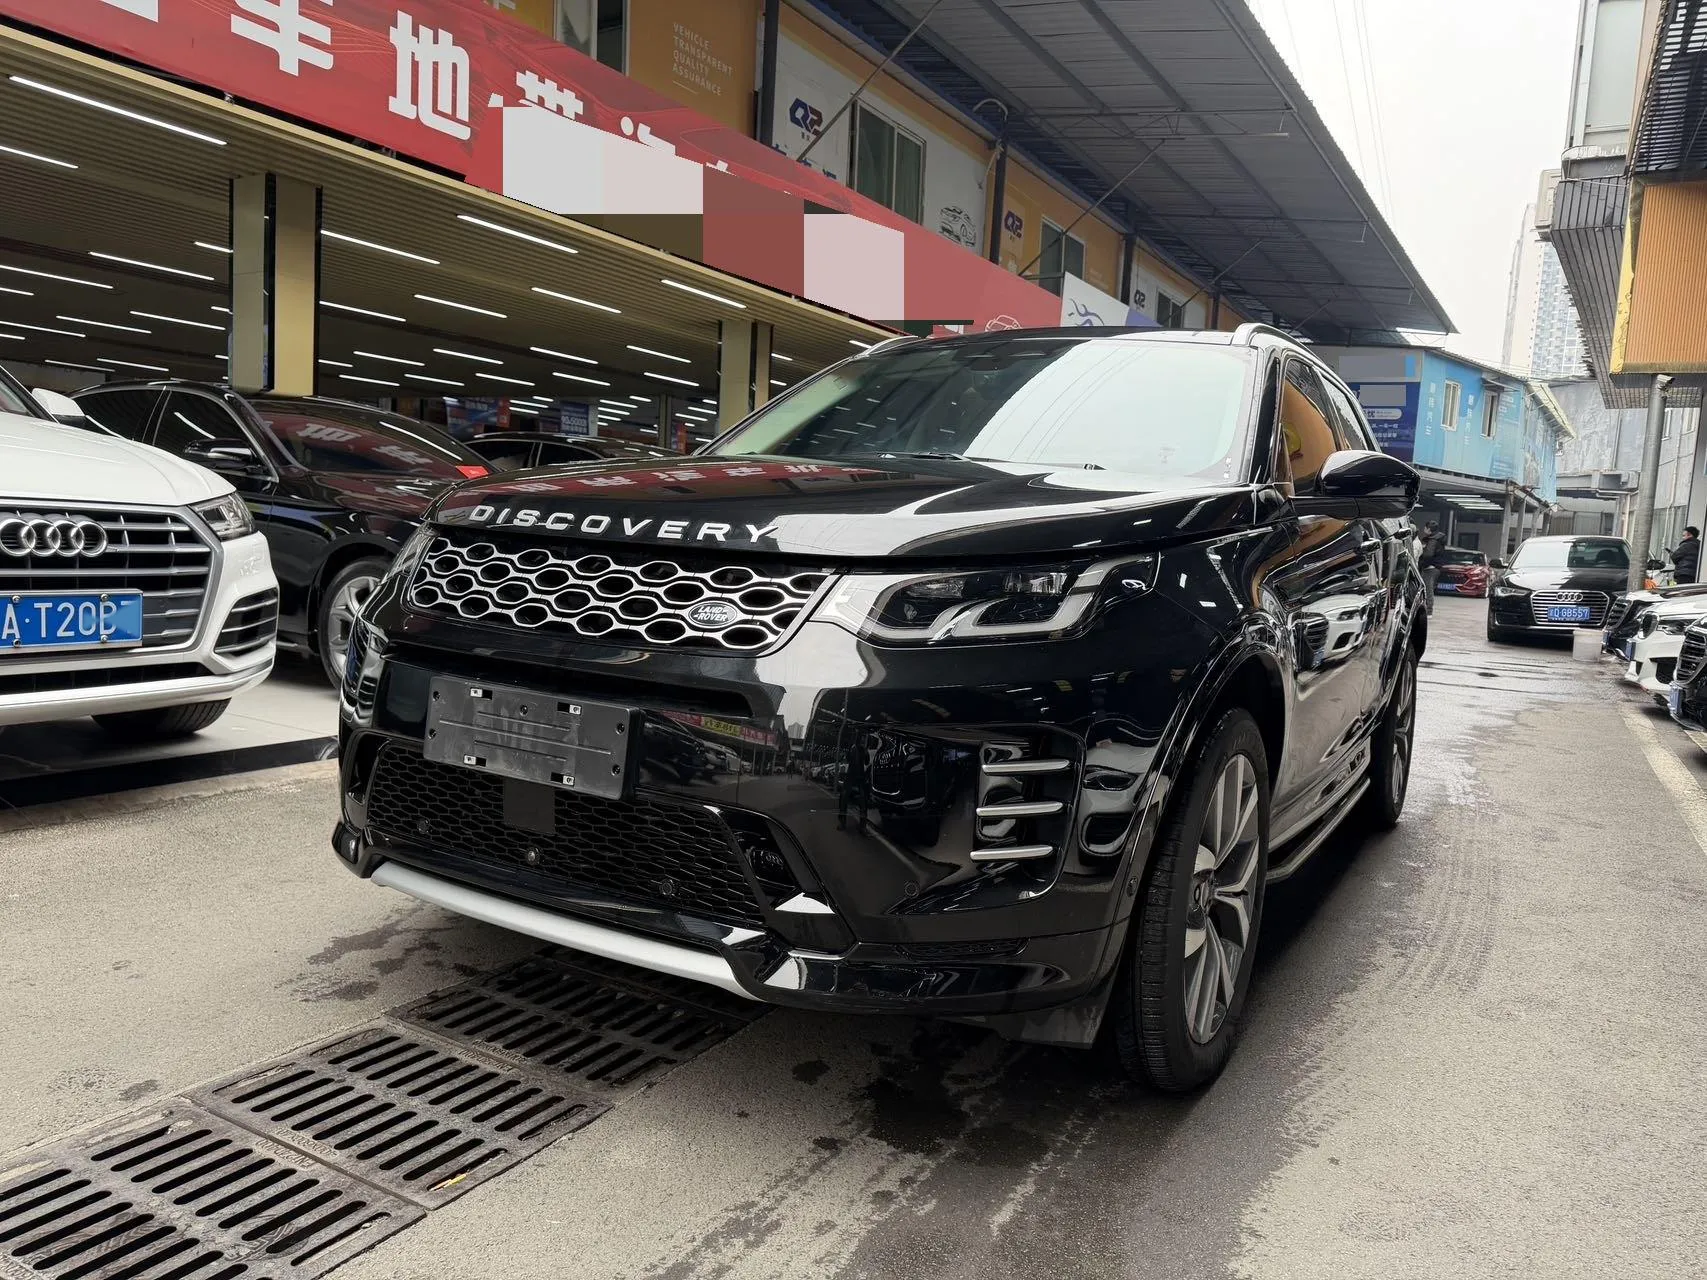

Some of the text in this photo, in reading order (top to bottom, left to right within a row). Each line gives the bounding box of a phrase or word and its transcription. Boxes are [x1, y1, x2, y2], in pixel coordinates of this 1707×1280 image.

[673, 23, 710, 50] VEHICLE
[673, 35, 733, 77] TRANSPARENT
[673, 49, 709, 78] QUALITY
[672, 62, 721, 96] ASSURANCE
[468, 504, 780, 543] DISCOVERY
[697, 605, 725, 614] LAND
[697, 612, 728, 622] ROVER
